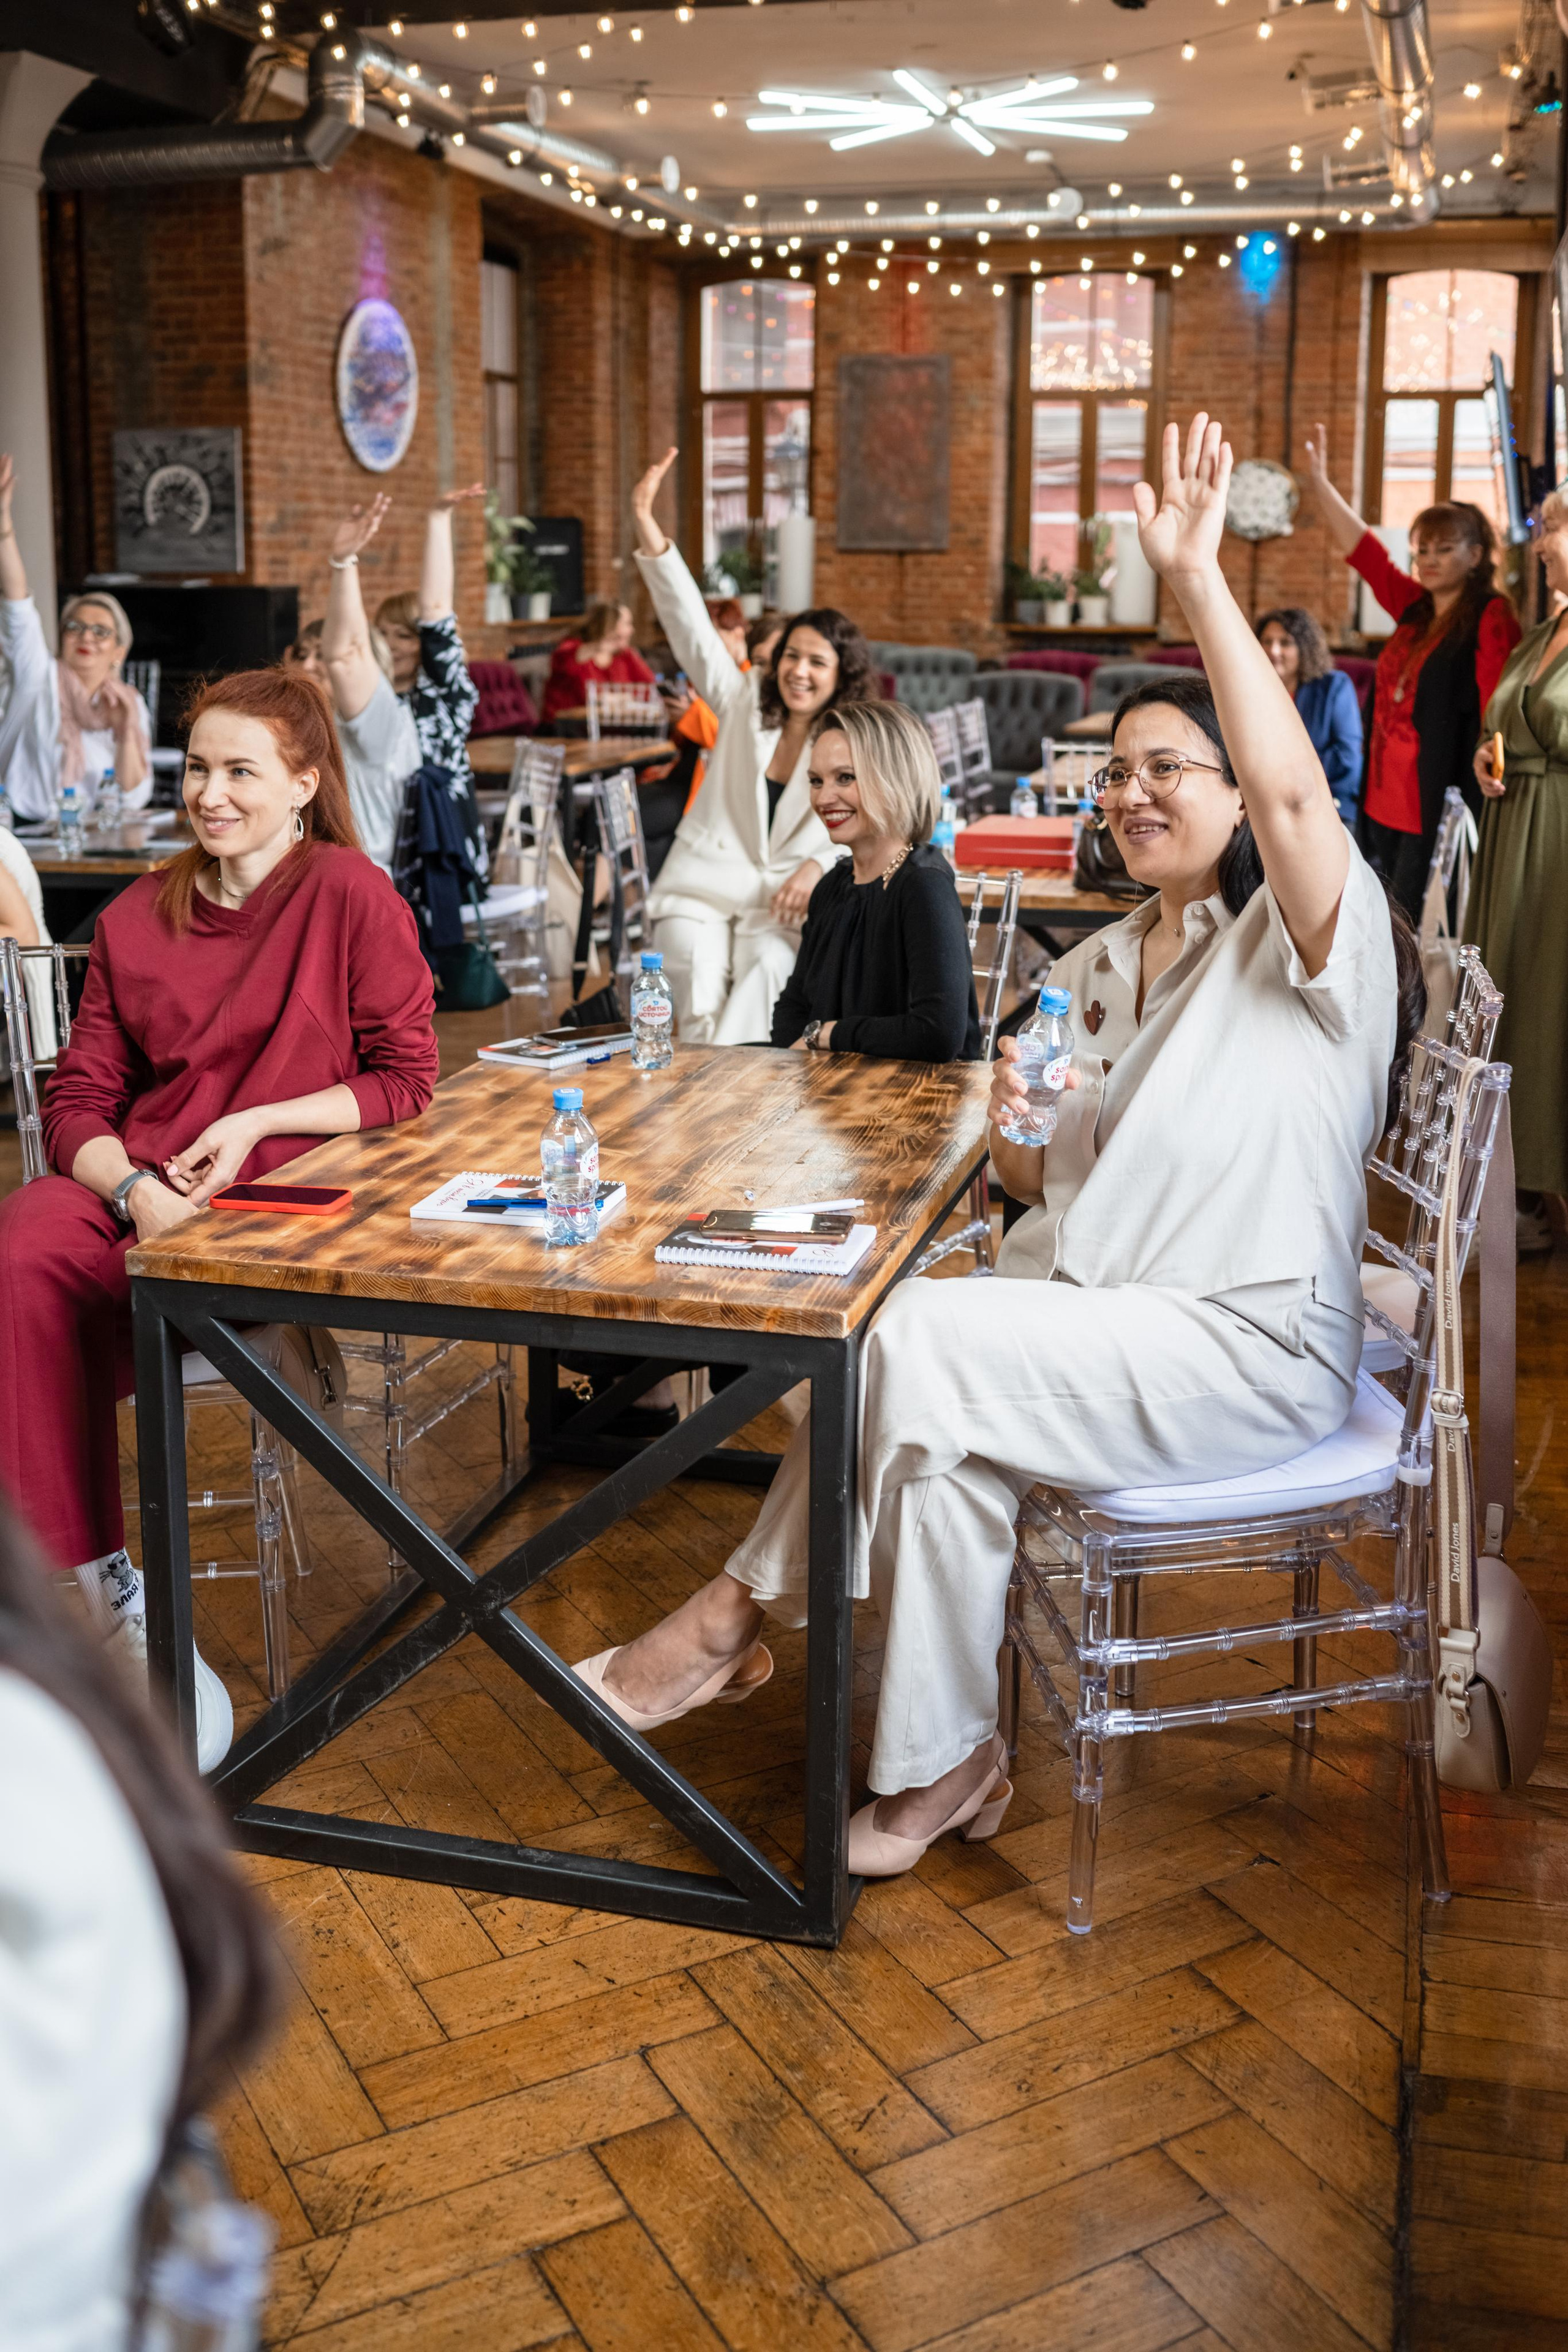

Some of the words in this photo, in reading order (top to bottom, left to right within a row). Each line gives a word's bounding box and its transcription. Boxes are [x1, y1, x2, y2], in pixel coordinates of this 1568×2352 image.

[1446, 1427, 1455, 1452] Davi
[1450, 1522, 1460, 1550] Jones
[1450, 1551, 1460, 1582] David
